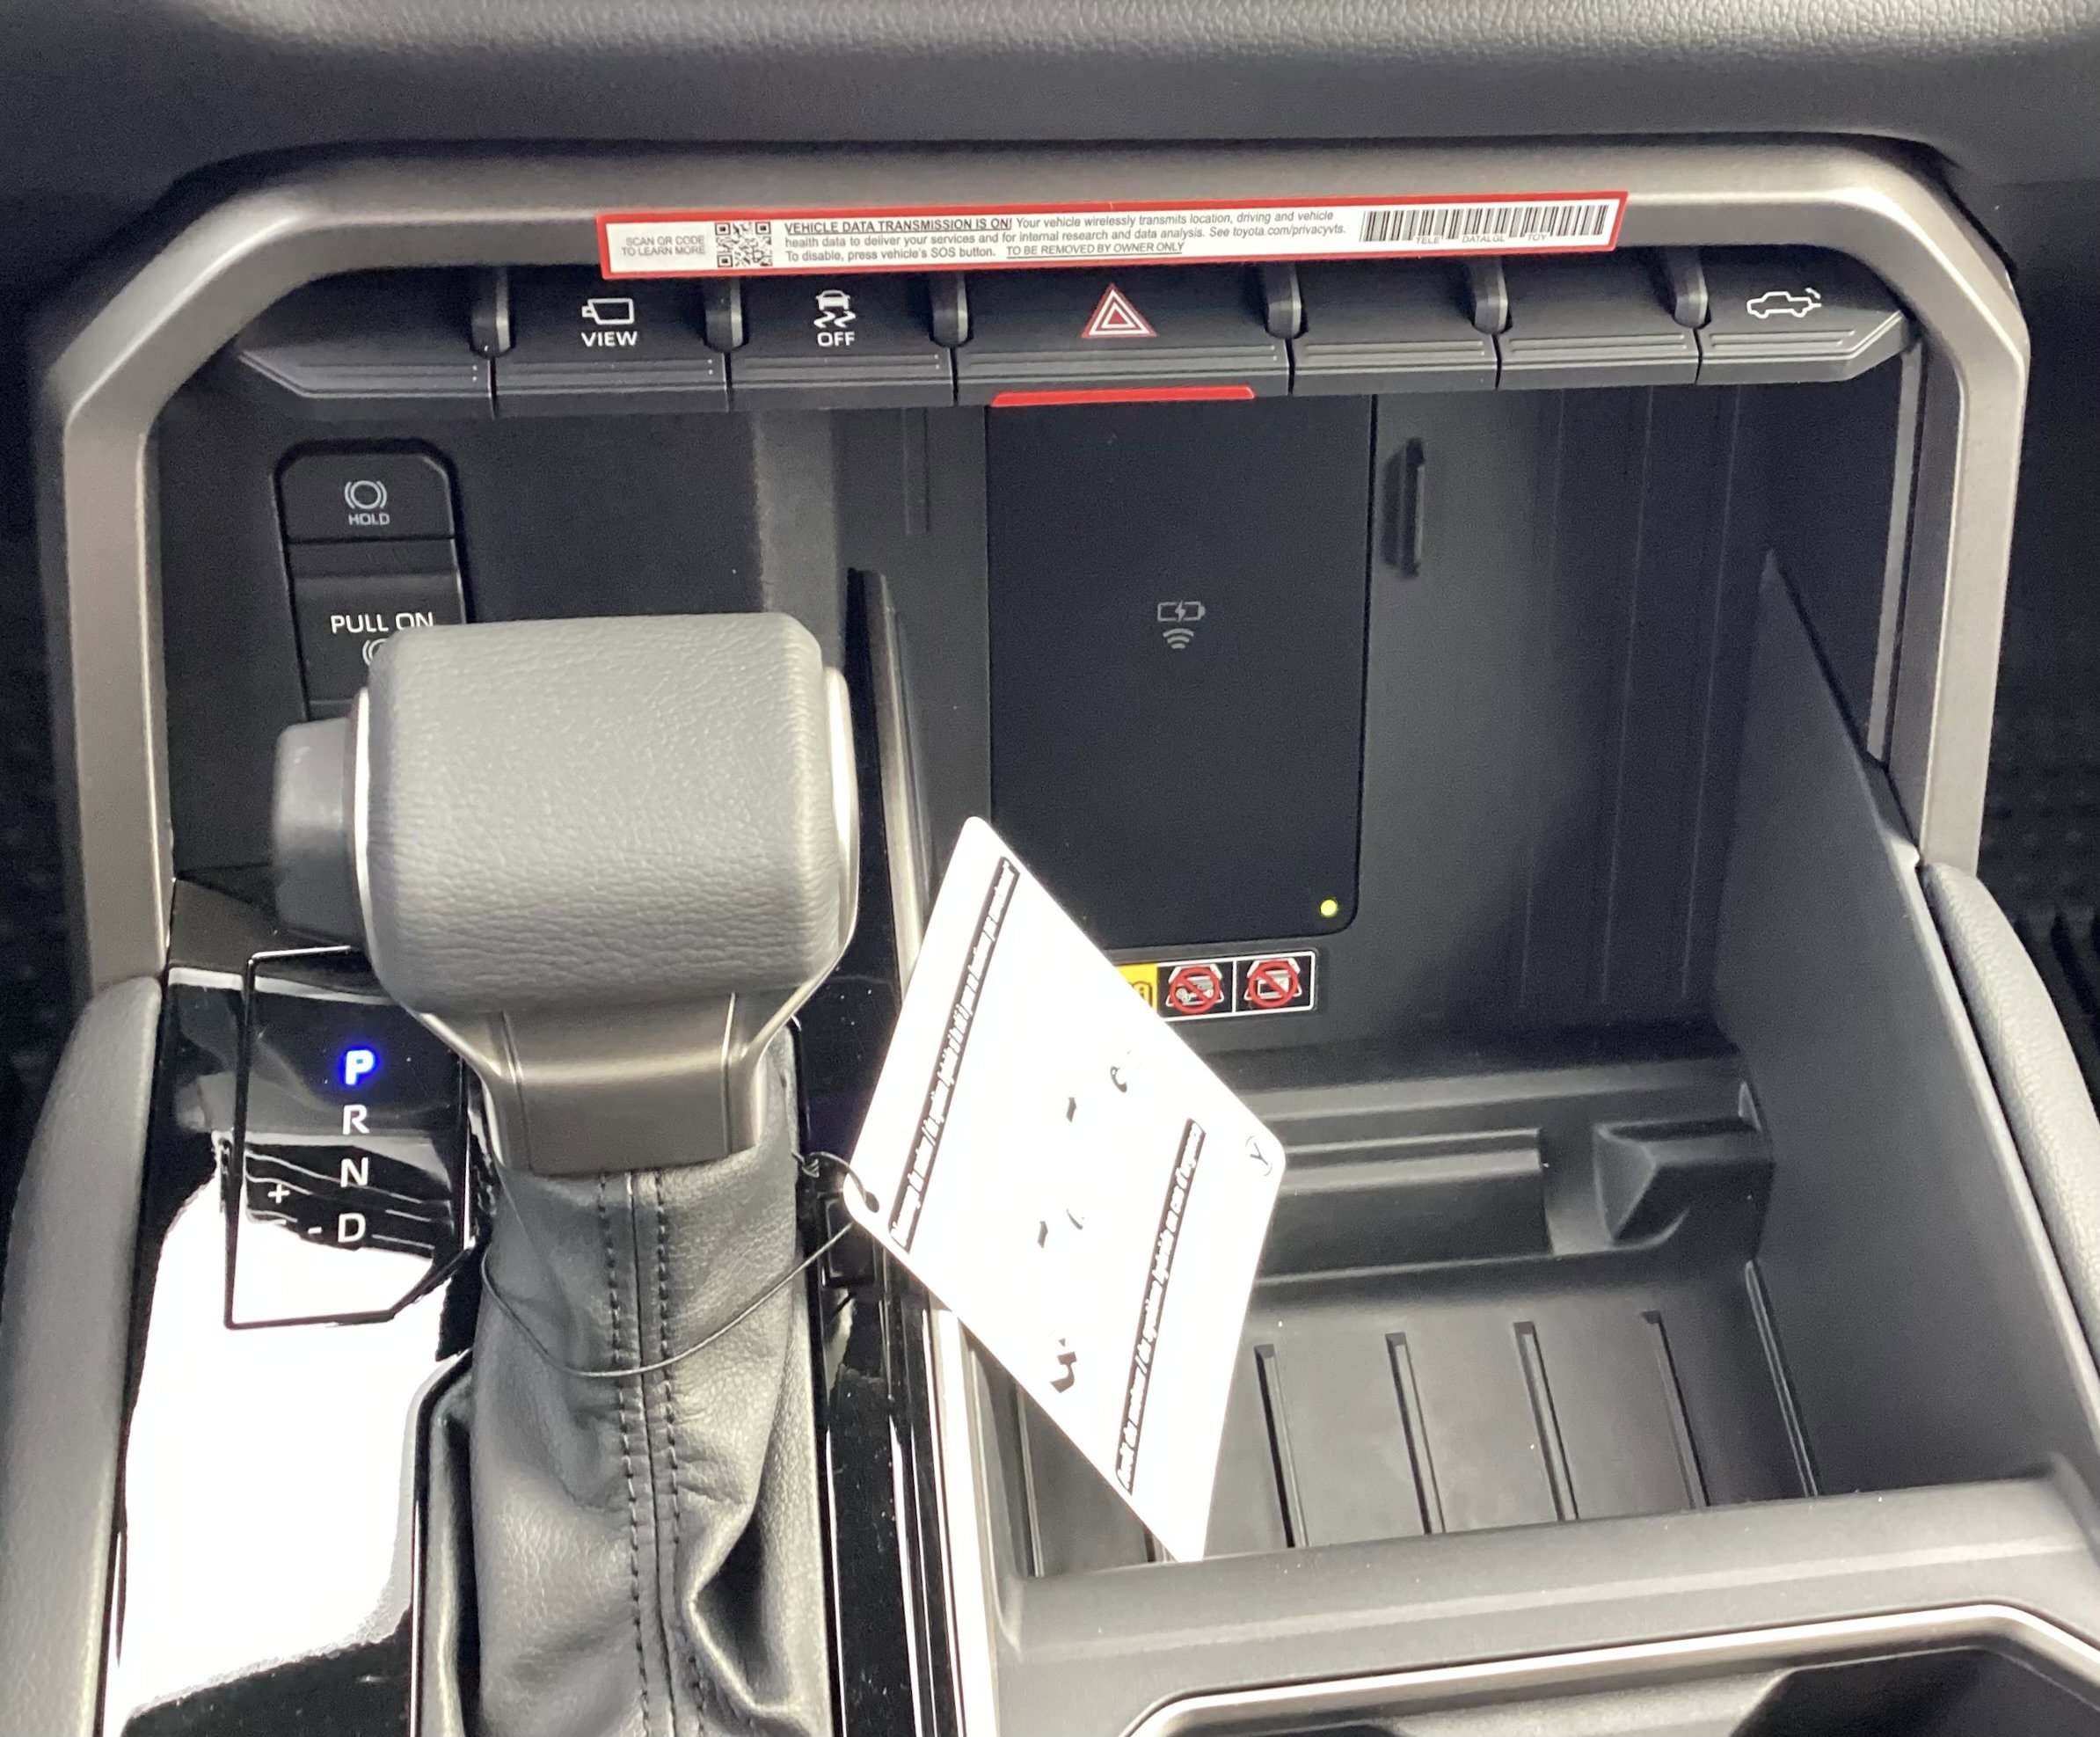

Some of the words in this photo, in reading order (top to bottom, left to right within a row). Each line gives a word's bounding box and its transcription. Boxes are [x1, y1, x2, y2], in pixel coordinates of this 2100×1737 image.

[784, 222, 839, 234] VEHICLE
[842, 221, 875, 233] DATA
[878, 218, 973, 232] TRANSMISSION
[975, 218, 987, 230] IS
[990, 217, 1012, 230] ON!
[1017, 217, 1040, 229] Your
[1044, 215, 1081, 228] vehicle
[1084, 215, 1136, 228] wirelessly
[1139, 214, 1187, 226] transmits
[1190, 213, 1233, 225] location,
[1236, 211, 1272, 224] driving
[1274, 211, 1294, 222] and
[1298, 210, 1334, 221] vehicle
[625, 236, 655, 247] SCAN
[657, 236, 673, 246] QR
[675, 235, 705, 245] CODE
[784, 236, 819, 248] health
[821, 236, 846, 247] data
[849, 237, 861, 246] to
[864, 235, 901, 246] deliver
[903, 236, 928, 248] your
[930, 233, 975, 244] services
[978, 231, 999, 244] and
[1002, 230, 1017, 243] for
[1019, 230, 1059, 242] internal
[1062, 229, 1108, 242] research
[1111, 228, 1131, 240] and
[1134, 227, 1157, 239] data
[1160, 226, 1206, 240] analysis.
[1209, 226, 1230, 237] See
[622, 247, 635, 257] TO
[638, 245, 673, 256] LEARN
[674, 244, 706, 255] MORE
[785, 250, 799, 262] To
[802, 250, 844, 262] disable,
[848, 250, 878, 263] press
[880, 248, 927, 259] vehicle's
[930, 247, 956, 258] SOS
[959, 246, 996, 258] button.
[1006, 245, 1021, 256] TO
[1024, 244, 1038, 255] BE
[1040, 244, 1095, 255] REMOVED
[1097, 243, 1112, 254] BY
[1113, 242, 1155, 253] OWNER
[1156, 241, 1185, 252] ONLY
[580, 331, 638, 347] VIEW
[817, 332, 856, 347] OFF
[348, 513, 390, 526] HOLD
[331, 614, 389, 634] PULL
[396, 612, 434, 629] ON
[345, 1049, 375, 1086] P
[342, 1104, 369, 1135] R
[339, 1157, 369, 1188] N
[337, 1213, 366, 1244] D
